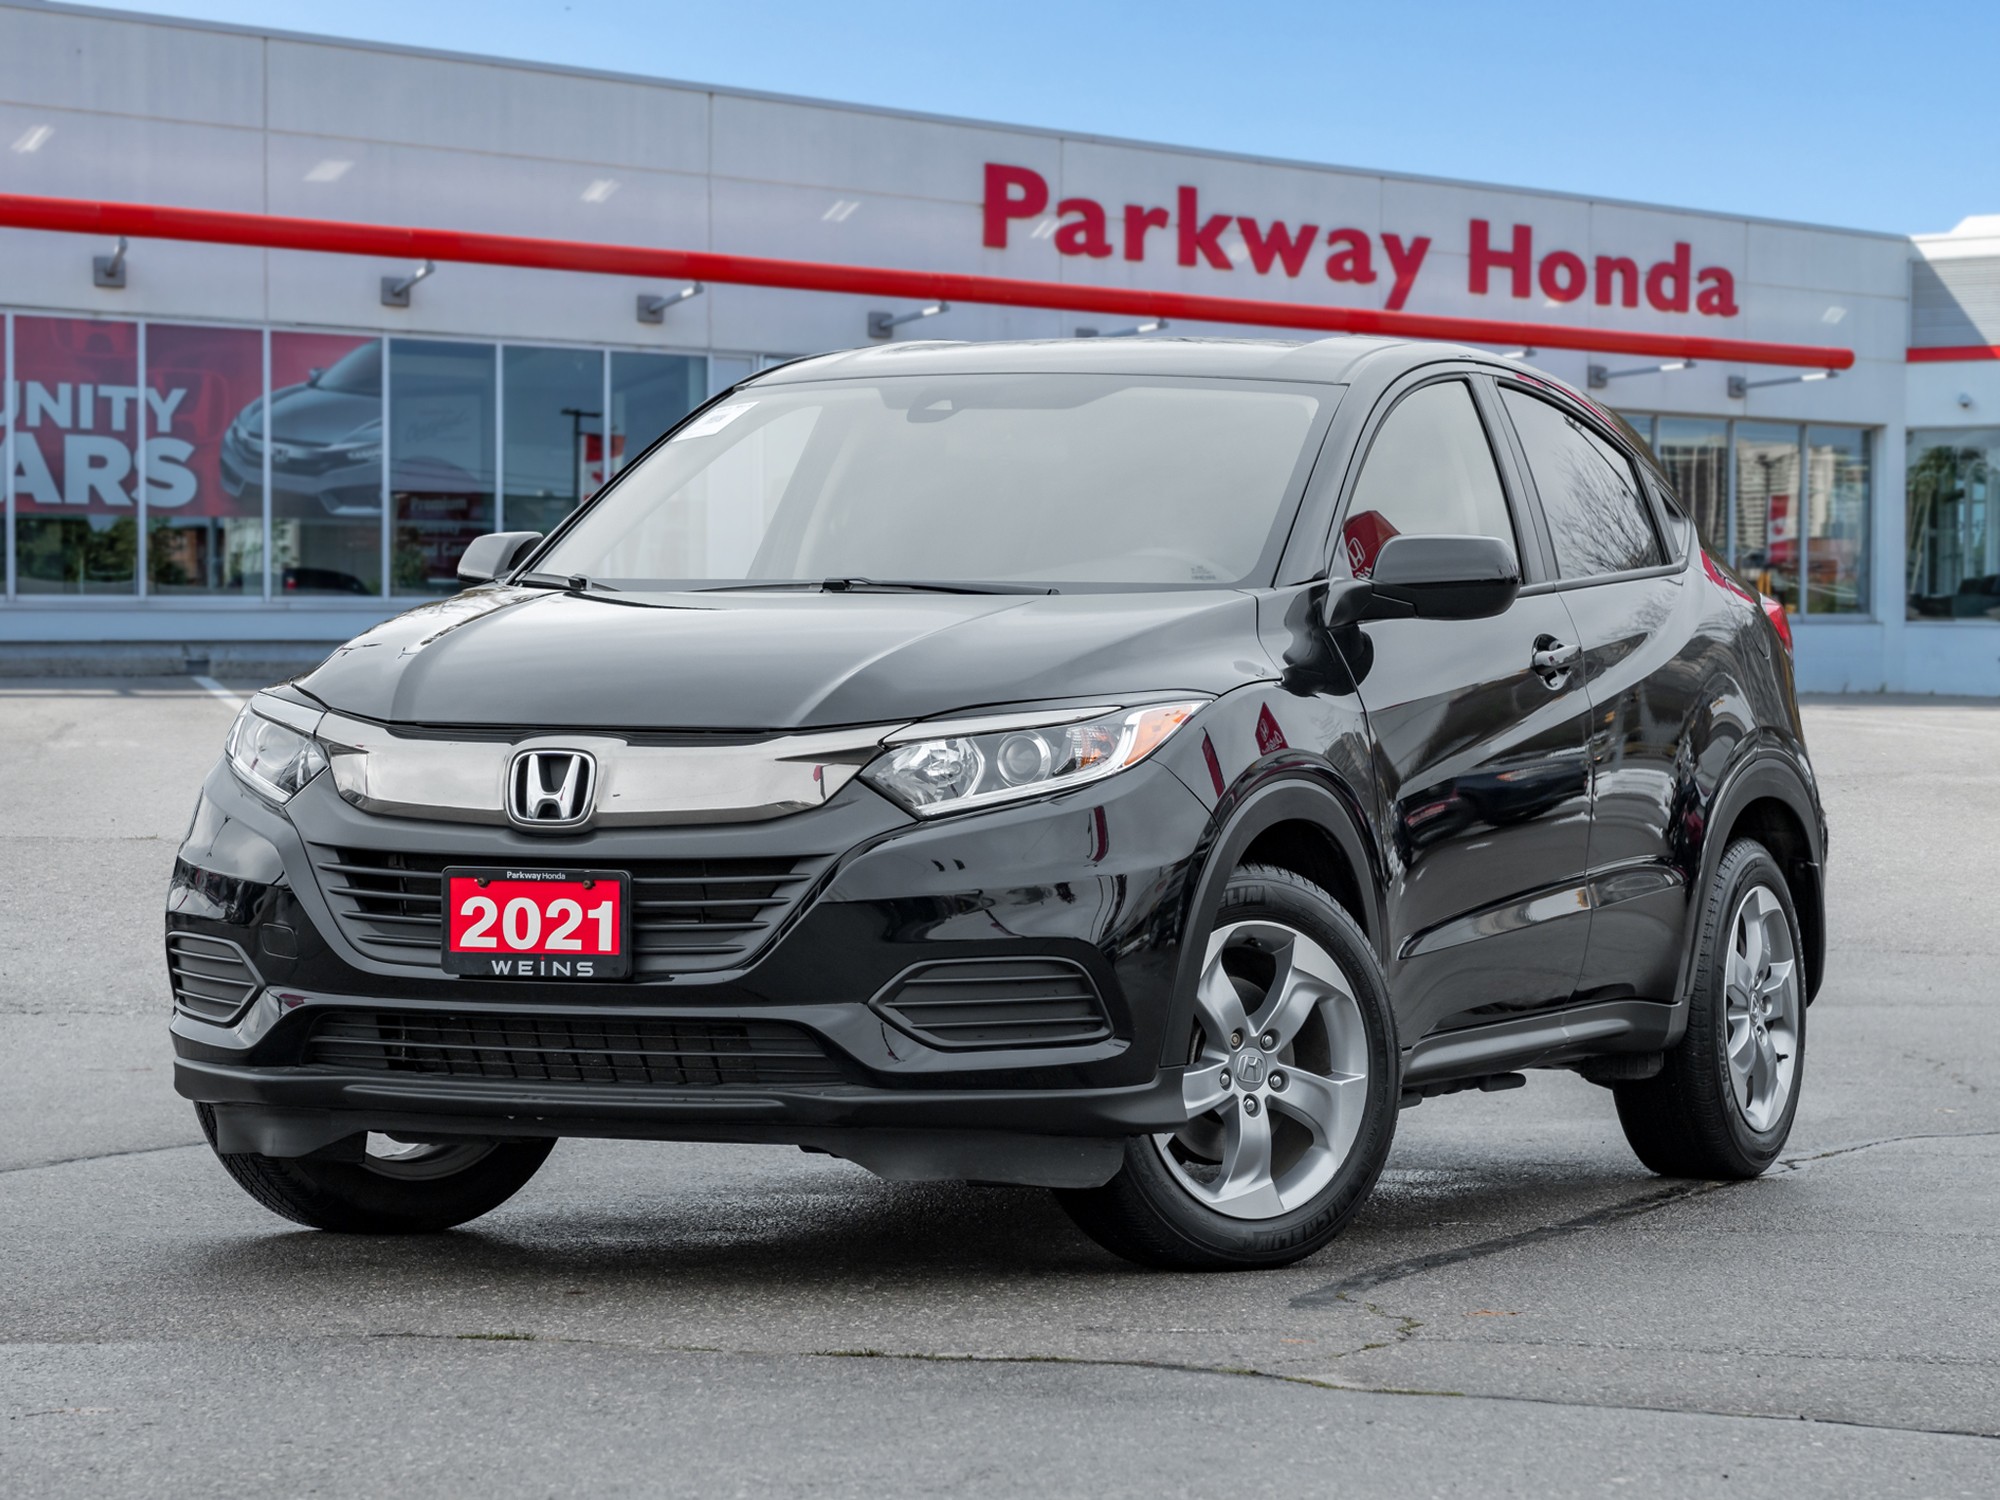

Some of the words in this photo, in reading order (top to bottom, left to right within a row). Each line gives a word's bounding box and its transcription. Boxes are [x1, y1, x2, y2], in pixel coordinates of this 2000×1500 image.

[983, 163, 1431, 311] Parkway
[1468, 219, 1739, 317] Honda
[506, 871, 541, 881] Parkway
[542, 872, 566, 880] Honda
[459, 896, 613, 951] 2021
[491, 960, 594, 976] WEINS
